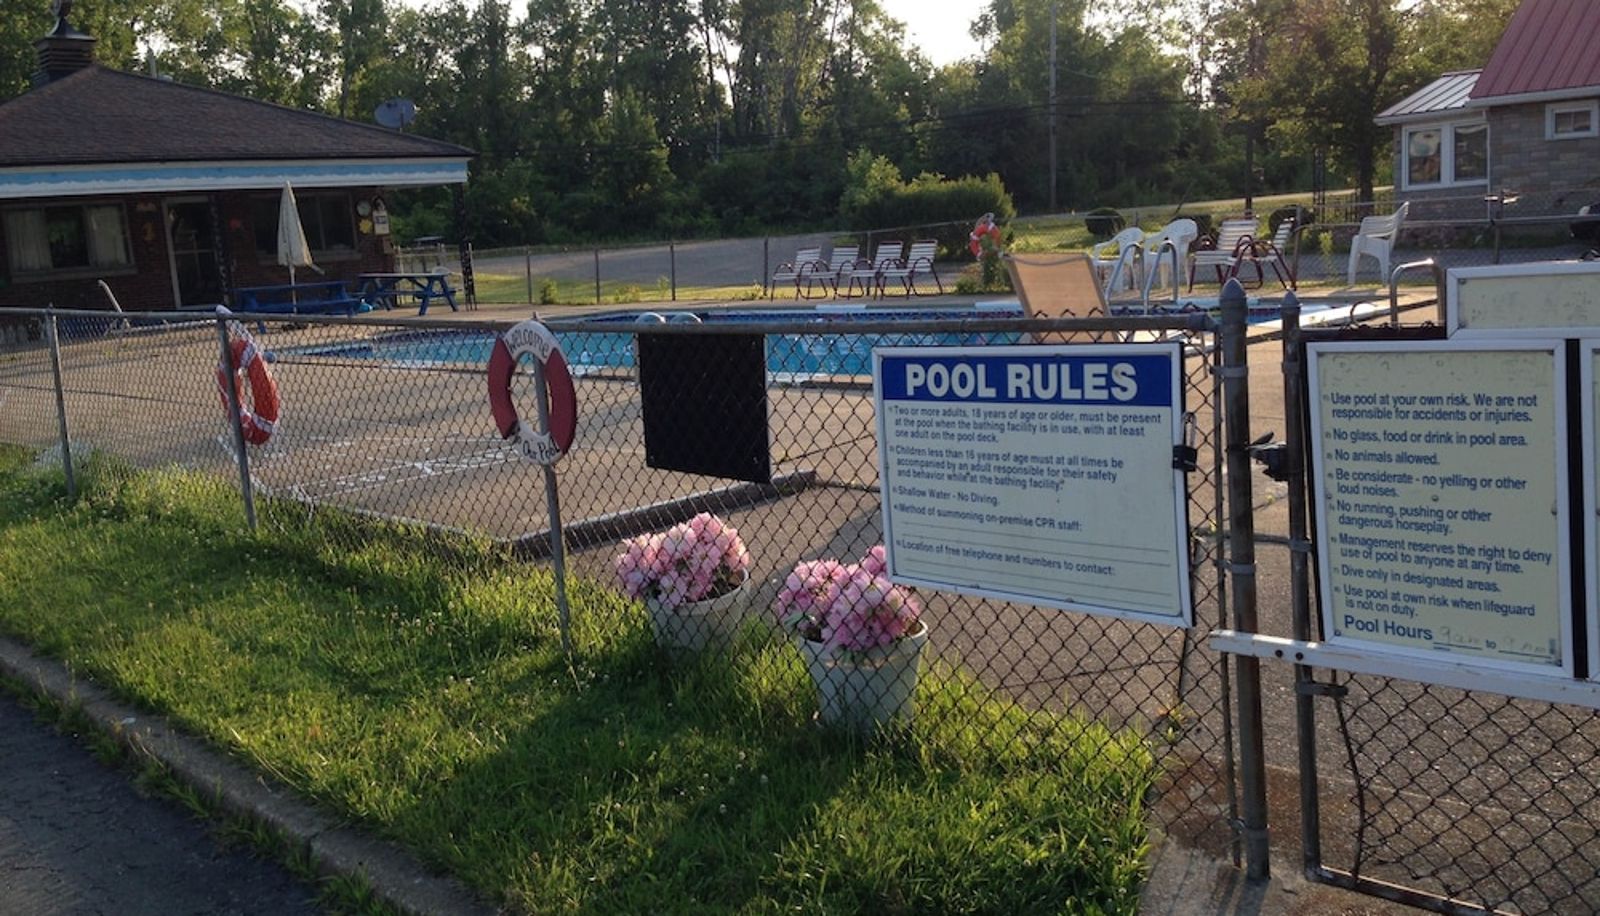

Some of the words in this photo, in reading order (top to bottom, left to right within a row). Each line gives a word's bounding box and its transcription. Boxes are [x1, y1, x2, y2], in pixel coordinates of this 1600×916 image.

[906, 364, 996, 398] POOL
[1008, 362, 1138, 400] RULES
[1331, 392, 1352, 404] Use
[1354, 393, 1377, 406] pool
[1380, 394, 1390, 405] at
[1392, 396, 1417, 407] your
[1419, 396, 1444, 405] own
[1446, 394, 1471, 406] risk.
[1473, 394, 1493, 406] We
[1496, 396, 1515, 407] are
[1517, 395, 1538, 406] not
[894, 406, 909, 415] Two
[983, 411, 1007, 420] years
[1008, 409, 1018, 419] of
[1020, 412, 1036, 421] age
[1038, 412, 1048, 420] or
[1050, 411, 1077, 422] older,
[1080, 412, 1104, 422] must
[1107, 412, 1120, 422] be
[1122, 414, 1161, 424] present
[1332, 407, 1394, 420] responsible
[1394, 408, 1411, 420] for
[1412, 408, 1467, 421] accidents
[1469, 411, 1483, 421] or
[1485, 409, 1533, 424] injuries.
[904, 418, 915, 427] the
[917, 419, 934, 429] pool
[935, 420, 956, 428] when
[958, 420, 971, 429] the
[973, 420, 1005, 433] bathing
[1007, 422, 1037, 434] facility
[1040, 423, 1048, 432] is
[1050, 423, 1059, 433] in
[1083, 425, 1105, 435] with
[1107, 426, 1117, 435] at
[1120, 426, 1145, 436] least
[911, 430, 929, 439] adult
[942, 431, 956, 440] the
[957, 432, 975, 442] pool
[977, 433, 999, 443] deck.
[1333, 429, 1348, 440] No
[1383, 430, 1408, 442] food
[1410, 433, 1422, 443] or
[1424, 432, 1454, 444] drink
[1456, 432, 1467, 444] in
[1470, 433, 1496, 447] pool
[1499, 436, 1528, 446] area.
[896, 446, 927, 456] Children
[928, 448, 944, 458] less
[945, 449, 964, 458] than
[977, 453, 1000, 462] years
[1002, 452, 1011, 462] of
[1013, 454, 1029, 464] age
[1030, 456, 1054, 464] must
[1056, 456, 1065, 465] at
[1067, 456, 1079, 465] all
[1081, 457, 1109, 468] times
[1111, 458, 1124, 468] be
[1335, 449, 1350, 461] No
[1352, 450, 1393, 463] animals
[1395, 452, 1440, 465] allowed.
[897, 458, 946, 469] accompanied
[947, 460, 956, 472] by
[958, 463, 969, 471] an
[971, 462, 992, 472] adult
[993, 465, 1044, 478] responsible
[1047, 467, 1060, 477] for
[1062, 468, 1085, 479] their
[1087, 471, 1117, 484] safety
[898, 469, 911, 477] and
[912, 470, 945, 480] behavior
[947, 473, 969, 482] while
[968, 474, 978, 483] at
[980, 475, 993, 485] the
[994, 476, 1027, 489] bathing
[1336, 469, 1350, 480] Be
[1352, 471, 1414, 484] considerate
[1422, 476, 1438, 485] no
[1439, 475, 1478, 490] yelling
[1480, 478, 1493, 488] or
[1495, 477, 1528, 490] other
[898, 486, 927, 497] Shallow
[928, 489, 951, 499] Water
[958, 492, 970, 501] No
[1337, 482, 1360, 494] loud
[1363, 484, 1399, 497] noises.
[900, 504, 926, 515] Method
[928, 507, 936, 516] of
[937, 509, 984, 523] summoning
[986, 514, 1034, 527] on-premise
[1035, 518, 1055, 528] CPR
[1058, 521, 1082, 531] staff:
[1337, 500, 1352, 512] No
[1354, 503, 1398, 517] running,
[1400, 506, 1444, 520] pushing
[1446, 510, 1459, 519] or
[1461, 509, 1492, 522] other
[1339, 514, 1394, 529] dangerous
[1396, 518, 1453, 535] horseplay.
[902, 540, 935, 552] Location
[936, 545, 944, 553] of
[945, 546, 961, 556] free
[962, 548, 1003, 561] telephone
[1005, 554, 1021, 563] and
[1022, 557, 1062, 569] numbers
[1064, 560, 1074, 571] to
[1076, 564, 1115, 575] contact:
[1339, 534, 1406, 552] Management
[1408, 542, 1455, 555] reserves
[1457, 544, 1476, 556] the
[1478, 546, 1506, 561] right
[1508, 548, 1521, 560] to
[1523, 549, 1552, 565] deny
[1341, 548, 1361, 558] use
[1362, 549, 1373, 560] of
[1376, 551, 1399, 563] pool
[1401, 552, 1412, 563] to
[1414, 555, 1456, 568] anyone
[1457, 558, 1469, 569] at
[1471, 560, 1492, 573] any
[1495, 560, 1523, 573] time.
[1342, 565, 1364, 578] Dive
[1366, 569, 1389, 582] only
[1391, 570, 1401, 582] in
[1403, 572, 1464, 589] designated
[1467, 580, 1501, 592] areas.
[1344, 585, 1363, 597] Use
[1366, 589, 1388, 600] pool
[1391, 591, 1401, 602] at
[1403, 594, 1426, 604] own
[1429, 594, 1449, 607] risk
[1451, 598, 1482, 610] when
[1484, 600, 1535, 616] lifeguard
[1345, 597, 1355, 608] is
[1357, 599, 1374, 611] not
[1376, 603, 1390, 613] on
[1392, 603, 1418, 617] duty.
[1344, 615, 1379, 633] Pool
[1384, 620, 1433, 640] Hours
[1486, 640, 1496, 649] to
